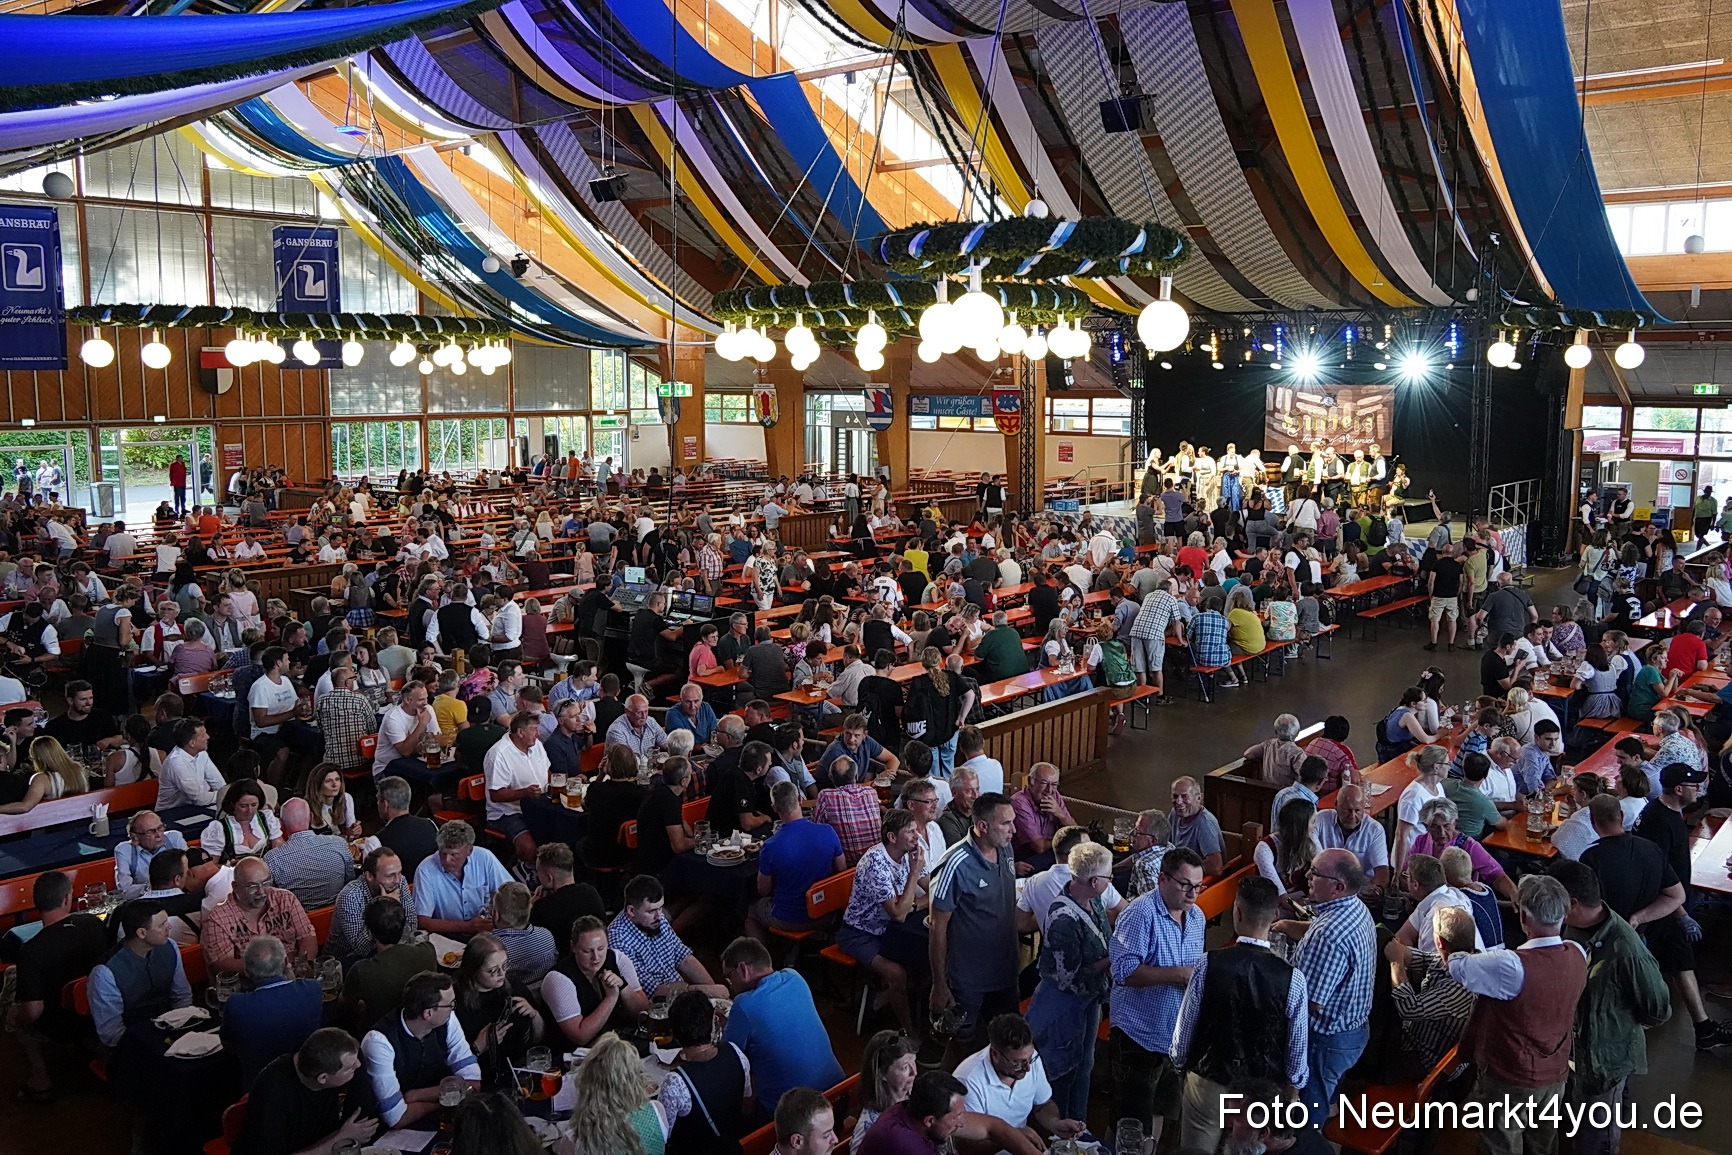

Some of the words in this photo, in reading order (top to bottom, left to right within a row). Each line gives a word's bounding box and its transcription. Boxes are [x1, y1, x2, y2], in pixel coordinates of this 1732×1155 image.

[0, 218, 50, 229] ANSBRÄU
[286, 237, 333, 247] GANSBRÄU
[2, 305, 51, 316] Neumarkt's
[0, 316, 21, 325] guter
[21, 315, 55, 325] Schluck
[936, 396, 950, 405] Wir
[950, 395, 975, 409] grüßen
[956, 406, 977, 416] Gäste!
[907, 719, 927, 734] NIKE
